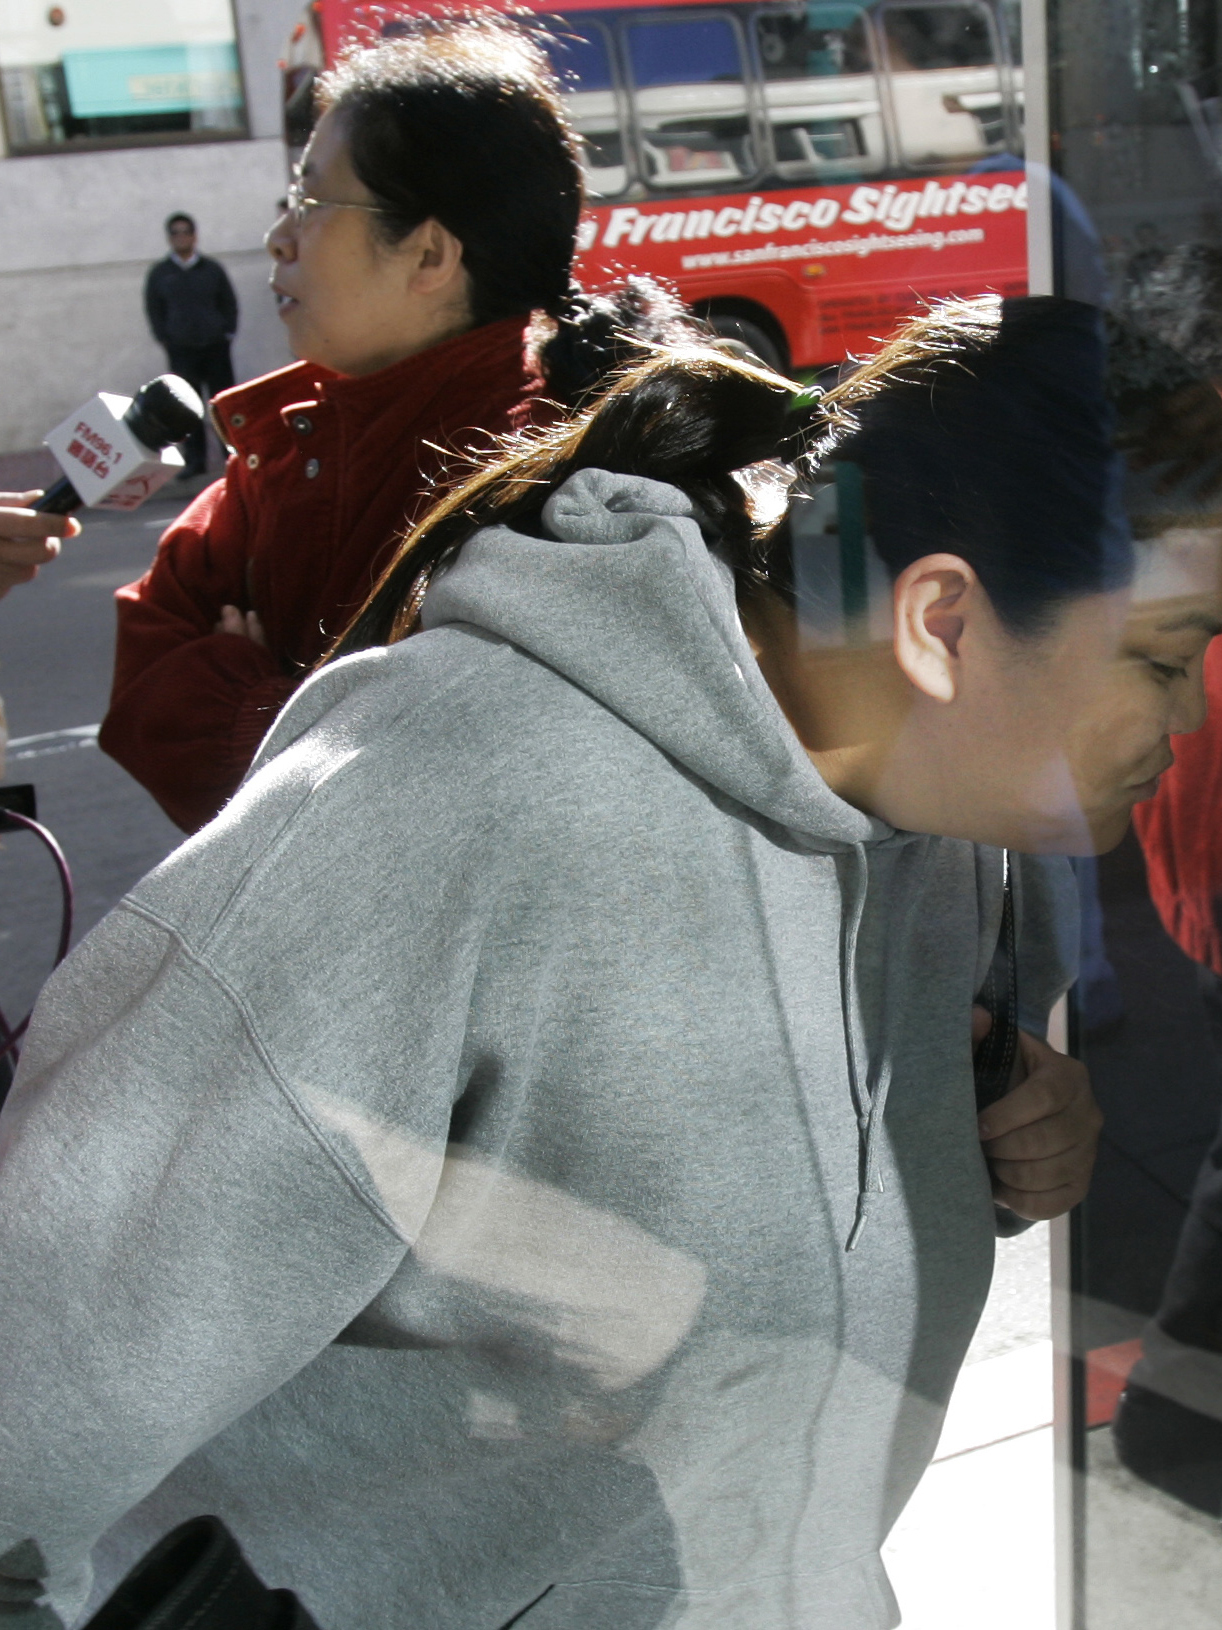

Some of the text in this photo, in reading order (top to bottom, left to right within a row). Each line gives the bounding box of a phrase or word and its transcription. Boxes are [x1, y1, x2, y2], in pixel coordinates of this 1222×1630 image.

[602, 196, 839, 248] Francisco
[681, 228, 985, 269] www.sanfranciscosightseeing.com
[74, 421, 123, 464] FM96.1
